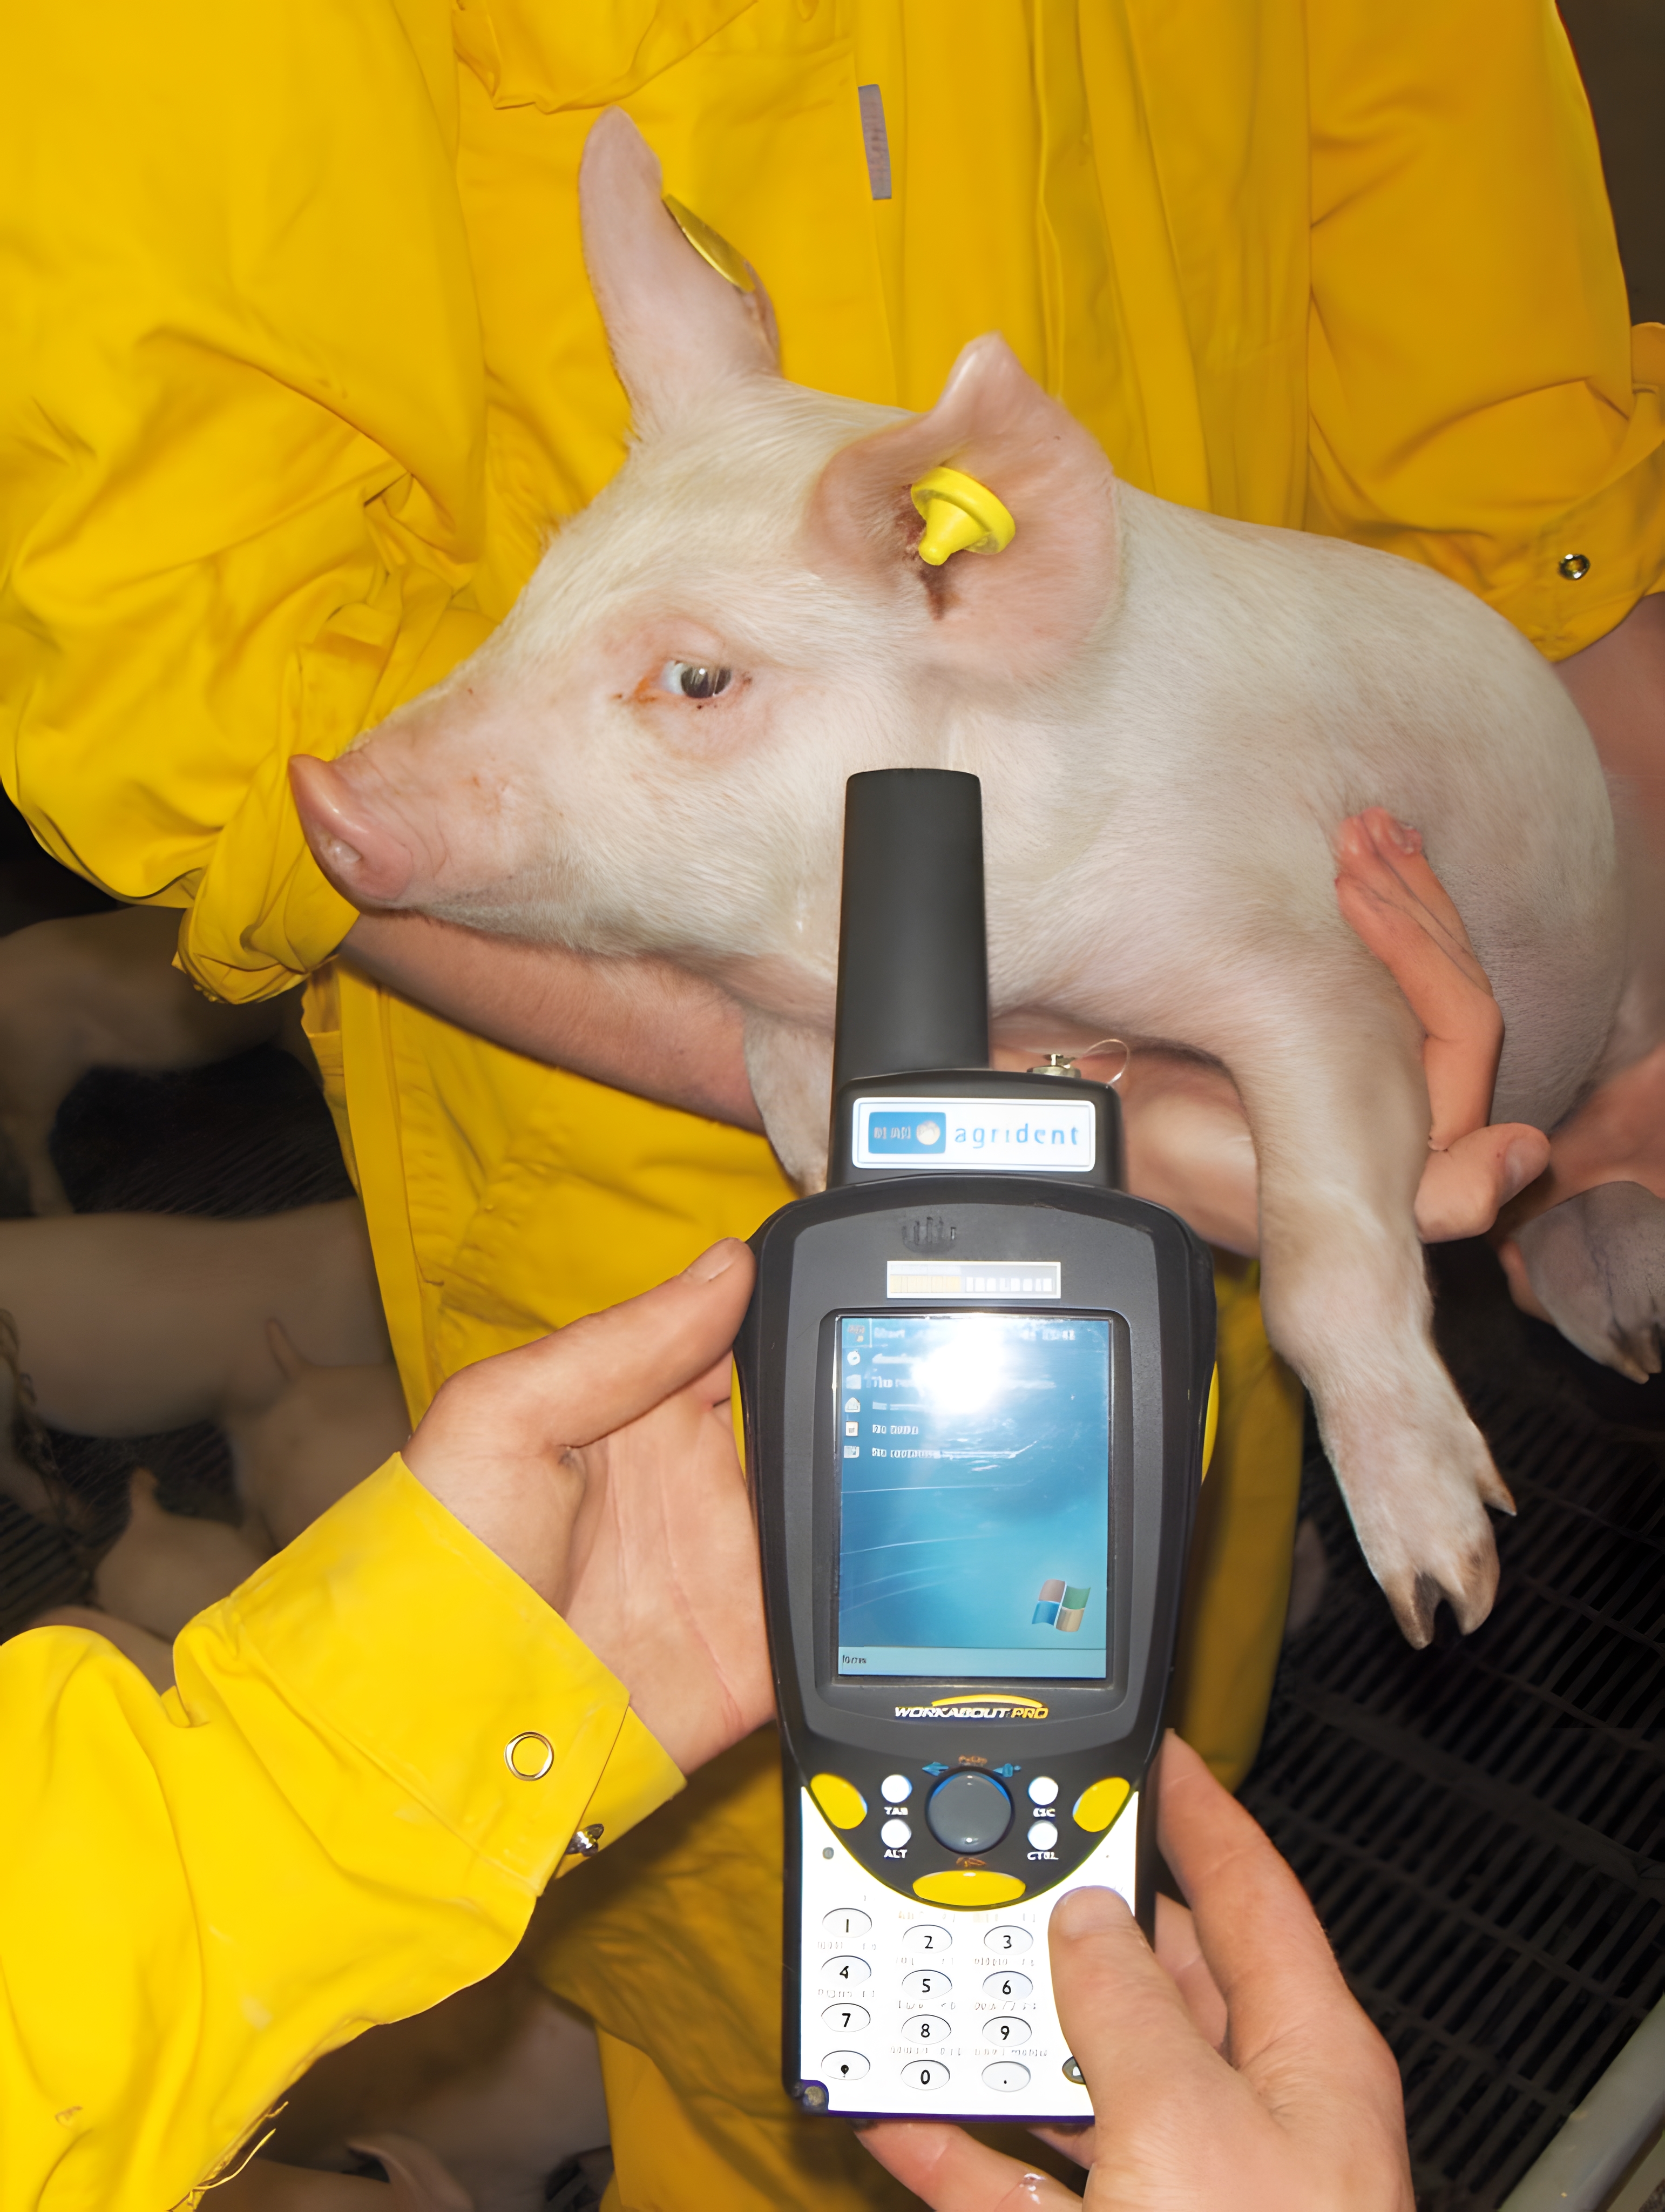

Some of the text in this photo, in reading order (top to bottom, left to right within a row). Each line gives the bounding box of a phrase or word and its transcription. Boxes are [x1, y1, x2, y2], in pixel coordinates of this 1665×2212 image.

[955, 1123, 1079, 1149] agrident
[895, 1706, 1012, 1718] WORKABOUT
[883, 1849, 908, 1859] ALT
[924, 1936, 933, 1949] 2
[1003, 1935, 1012, 1949] 3
[839, 1965, 849, 1979] 4
[922, 1978, 931, 1993] 5
[1002, 1980, 1012, 1995] 6
[842, 2013, 851, 2028] 7
[921, 2023, 930, 2038] 8
[1000, 2025, 1010, 2040] 9
[920, 2069, 930, 2085] 0
